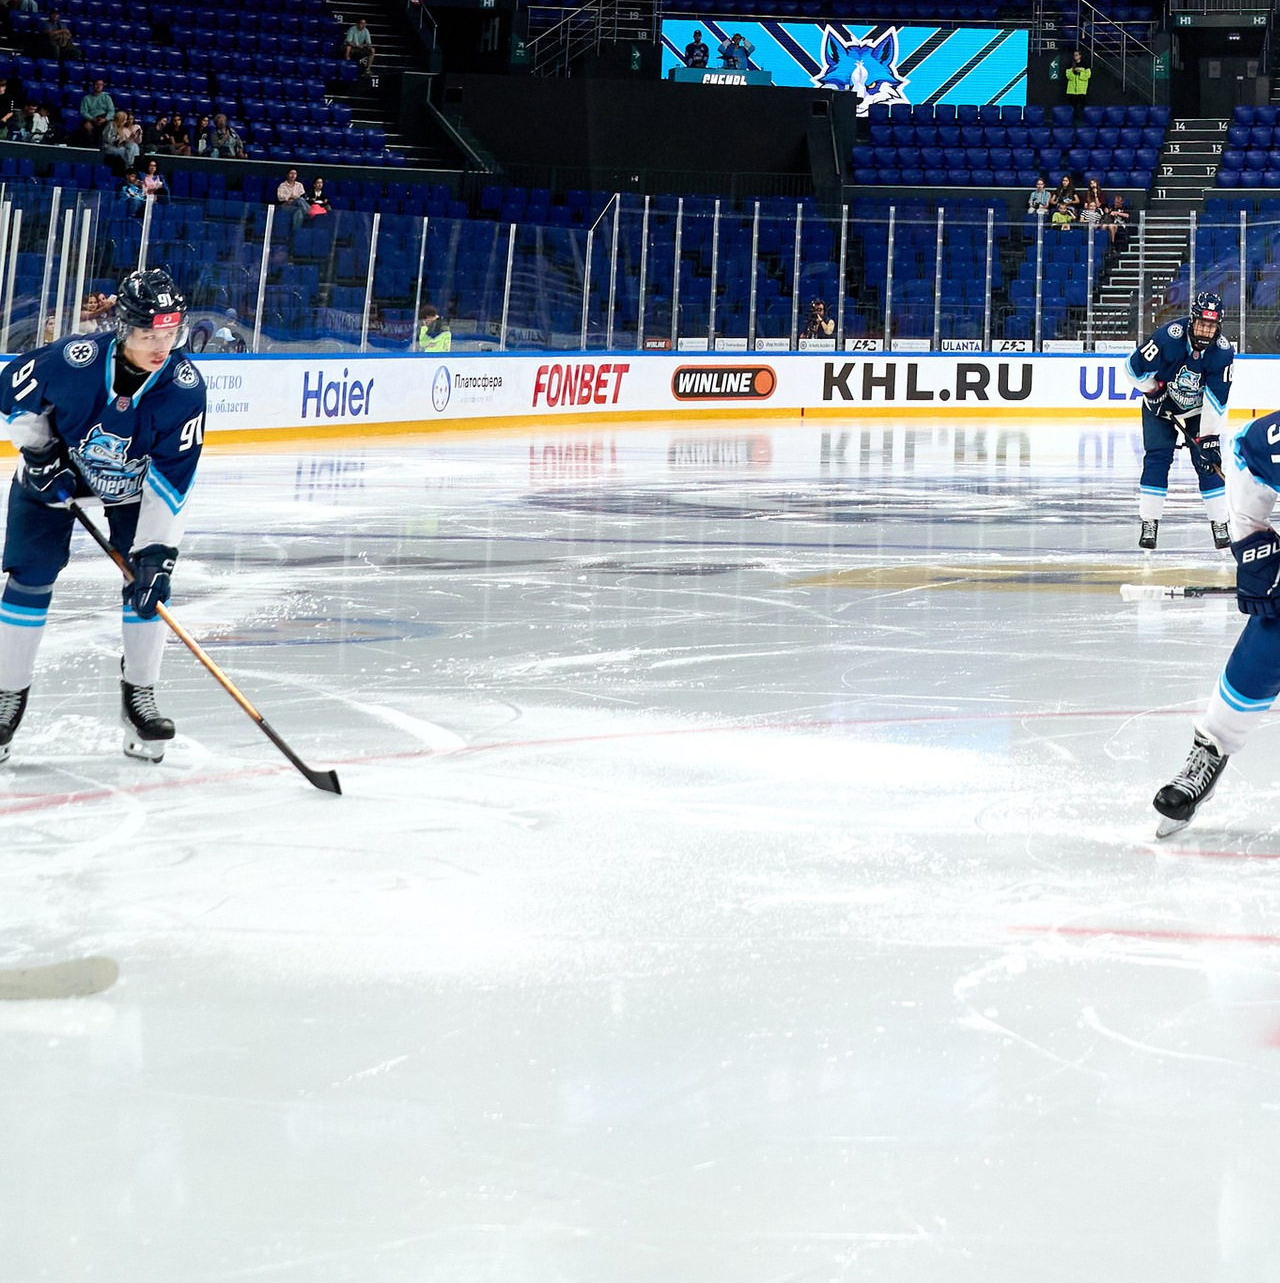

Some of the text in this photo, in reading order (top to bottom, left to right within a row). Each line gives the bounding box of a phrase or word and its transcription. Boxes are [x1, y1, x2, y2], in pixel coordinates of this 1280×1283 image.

[484, 0, 495, 8] H1
[1180, 17, 1267, 25] H1 H2
[1176, 122, 1228, 131] 14 14
[1170, 145, 1222, 153] 13 13
[1162, 167, 1216, 175] 12 12
[1158, 190, 1166, 198] 11
[157, 293, 174, 307] 91
[942, 341, 980, 351] ULANTA
[1140, 339, 1160, 362] 18
[12, 359, 38, 402] 91
[454, 374, 503, 391] Платосфера
[532, 363, 630, 407] FONBET
[678, 373, 752, 393] WINLINE
[823, 362, 1033, 401] KHL.RU
[301, 367, 374, 418] Haier
[216, 400, 249, 413] области
[179, 412, 204, 452] 91
